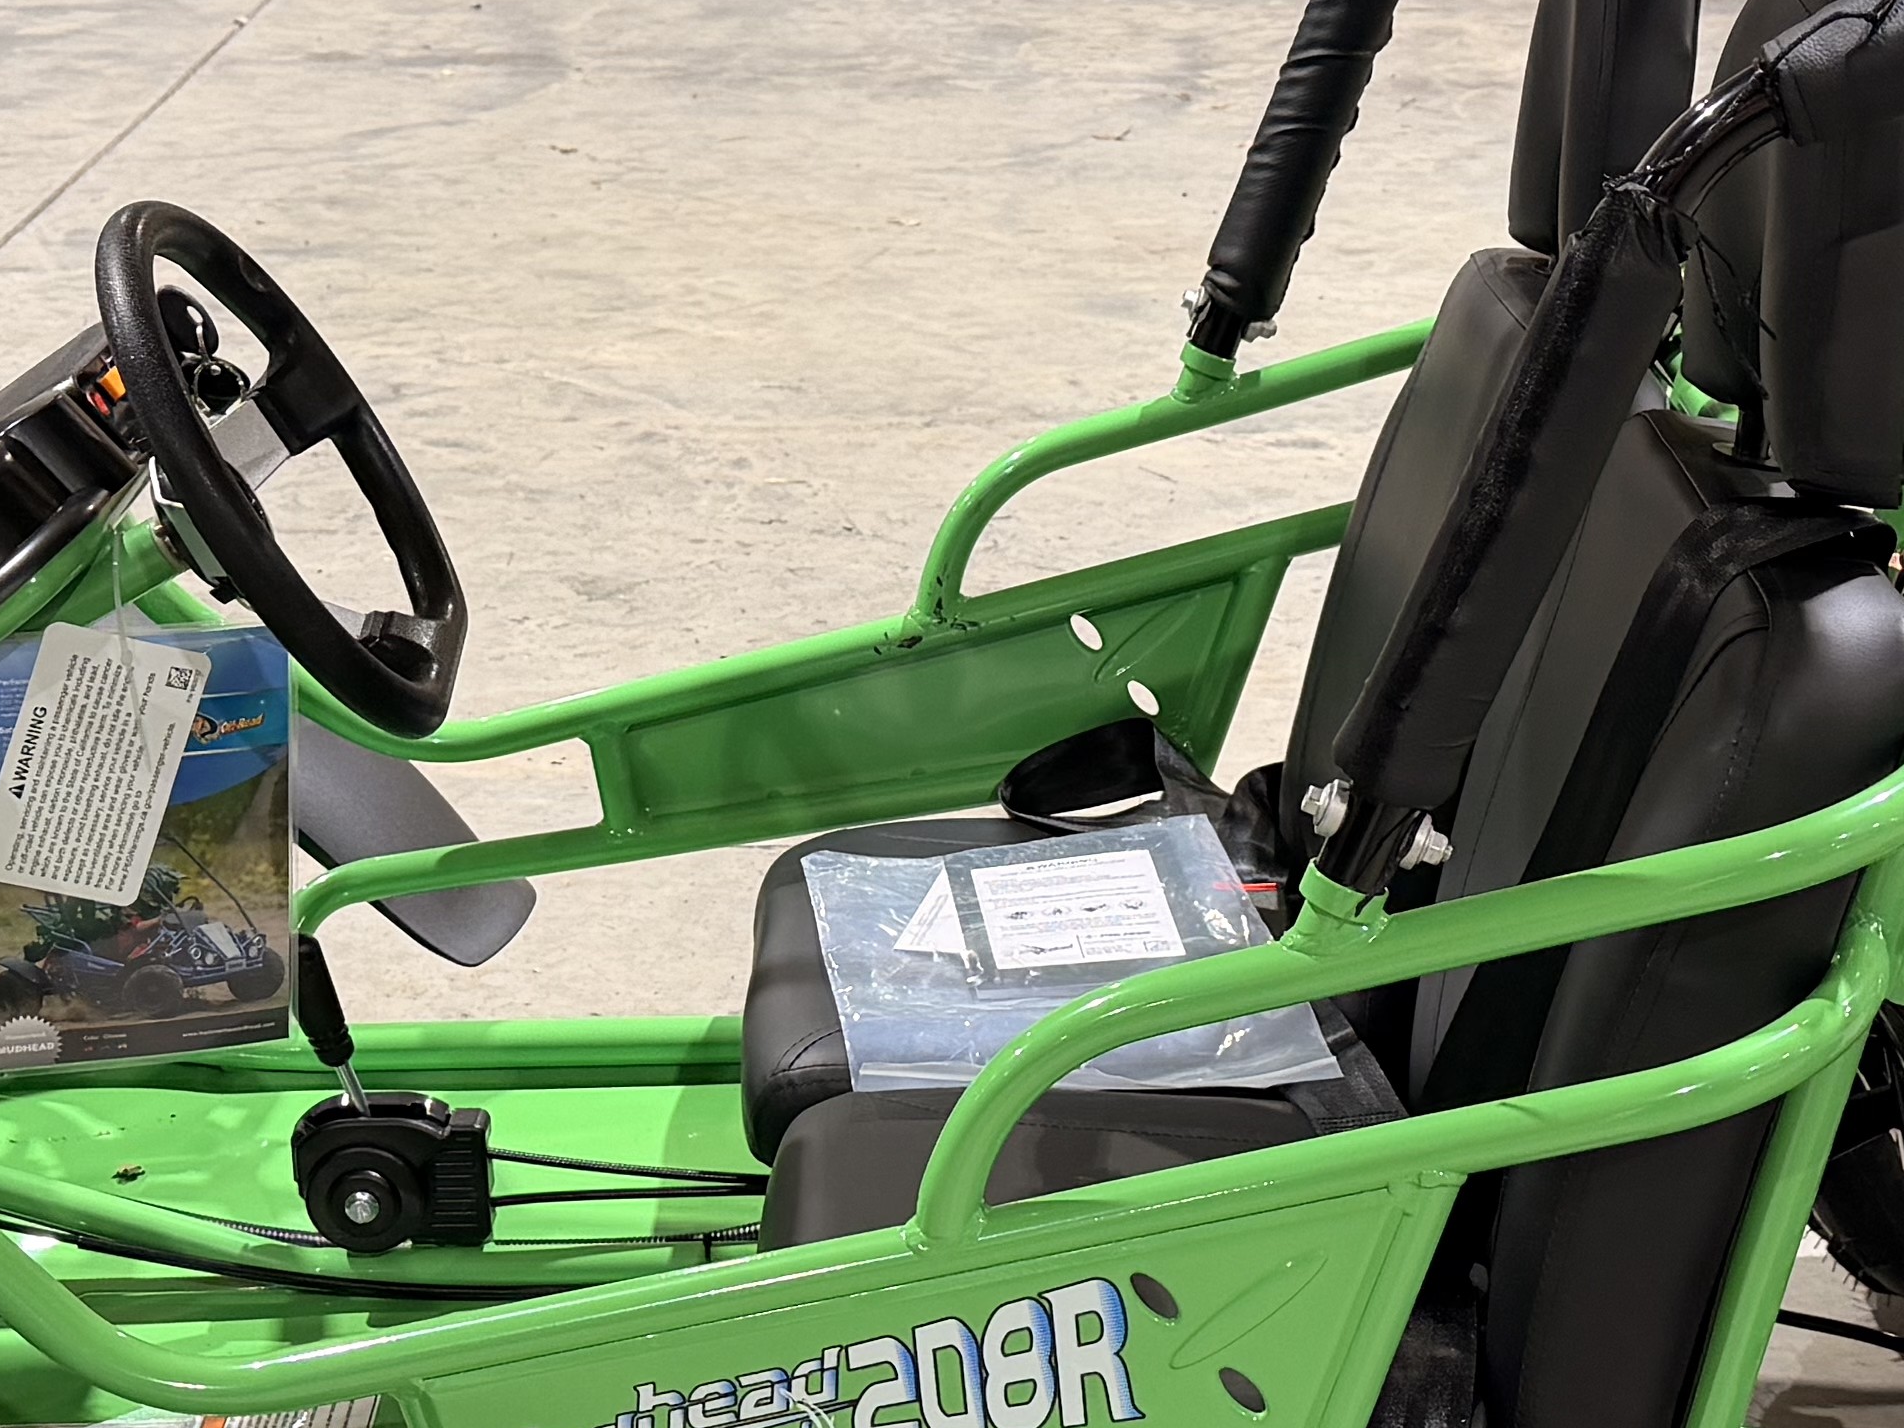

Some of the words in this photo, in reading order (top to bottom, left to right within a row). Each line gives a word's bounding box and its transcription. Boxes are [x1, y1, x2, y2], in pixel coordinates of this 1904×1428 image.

[50, 683, 71, 724] passenger
[63, 653, 80, 682] vehicle
[105, 664, 124, 700] minimize
[142, 671, 157, 697] hands
[110, 707, 123, 722] idle
[136, 697, 149, 715] your
[13, 705, 48, 781] WARNING
[112, 727, 128, 755] vehicle
[18, 832, 36, 864] off-road
[28, 804, 45, 832] vehicle
[42, 758, 59, 788] expose
[60, 693, 80, 732] chemicals
[72, 656, 91, 692] including
[38, 854, 52, 877] which
[50, 813, 65, 839] known
[65, 767, 80, 789] State
[75, 719, 95, 757] California
[90, 685, 105, 710] cause
[98, 657, 114, 685] cancer
[79, 735, 101, 784] reproductive
[106, 756, 119, 774] your
[118, 748, 133, 774] gloves
[72, 784, 86, 805] other
[97, 775, 113, 803] service
[111, 775, 125, 795] wear
[124, 773, 137, 791] your
[79, 783, 99, 820] breathing
[112, 792, 132, 827] servicing
[27, 849, 43, 875] engine
[46, 786, 62, 814] carbon
[60, 816, 76, 845] defects
[72, 821, 87, 843] avoid
[100, 812, 113, 831] area
[115, 811, 136, 854] information
[105, 827, 120, 849] when
[54, 845, 67, 864] birth
[83, 831, 107, 886] well-ventilated
[109, 855, 123, 876] more
[71, 858, 87, 884] except
[93, 850, 113, 888] frequently
